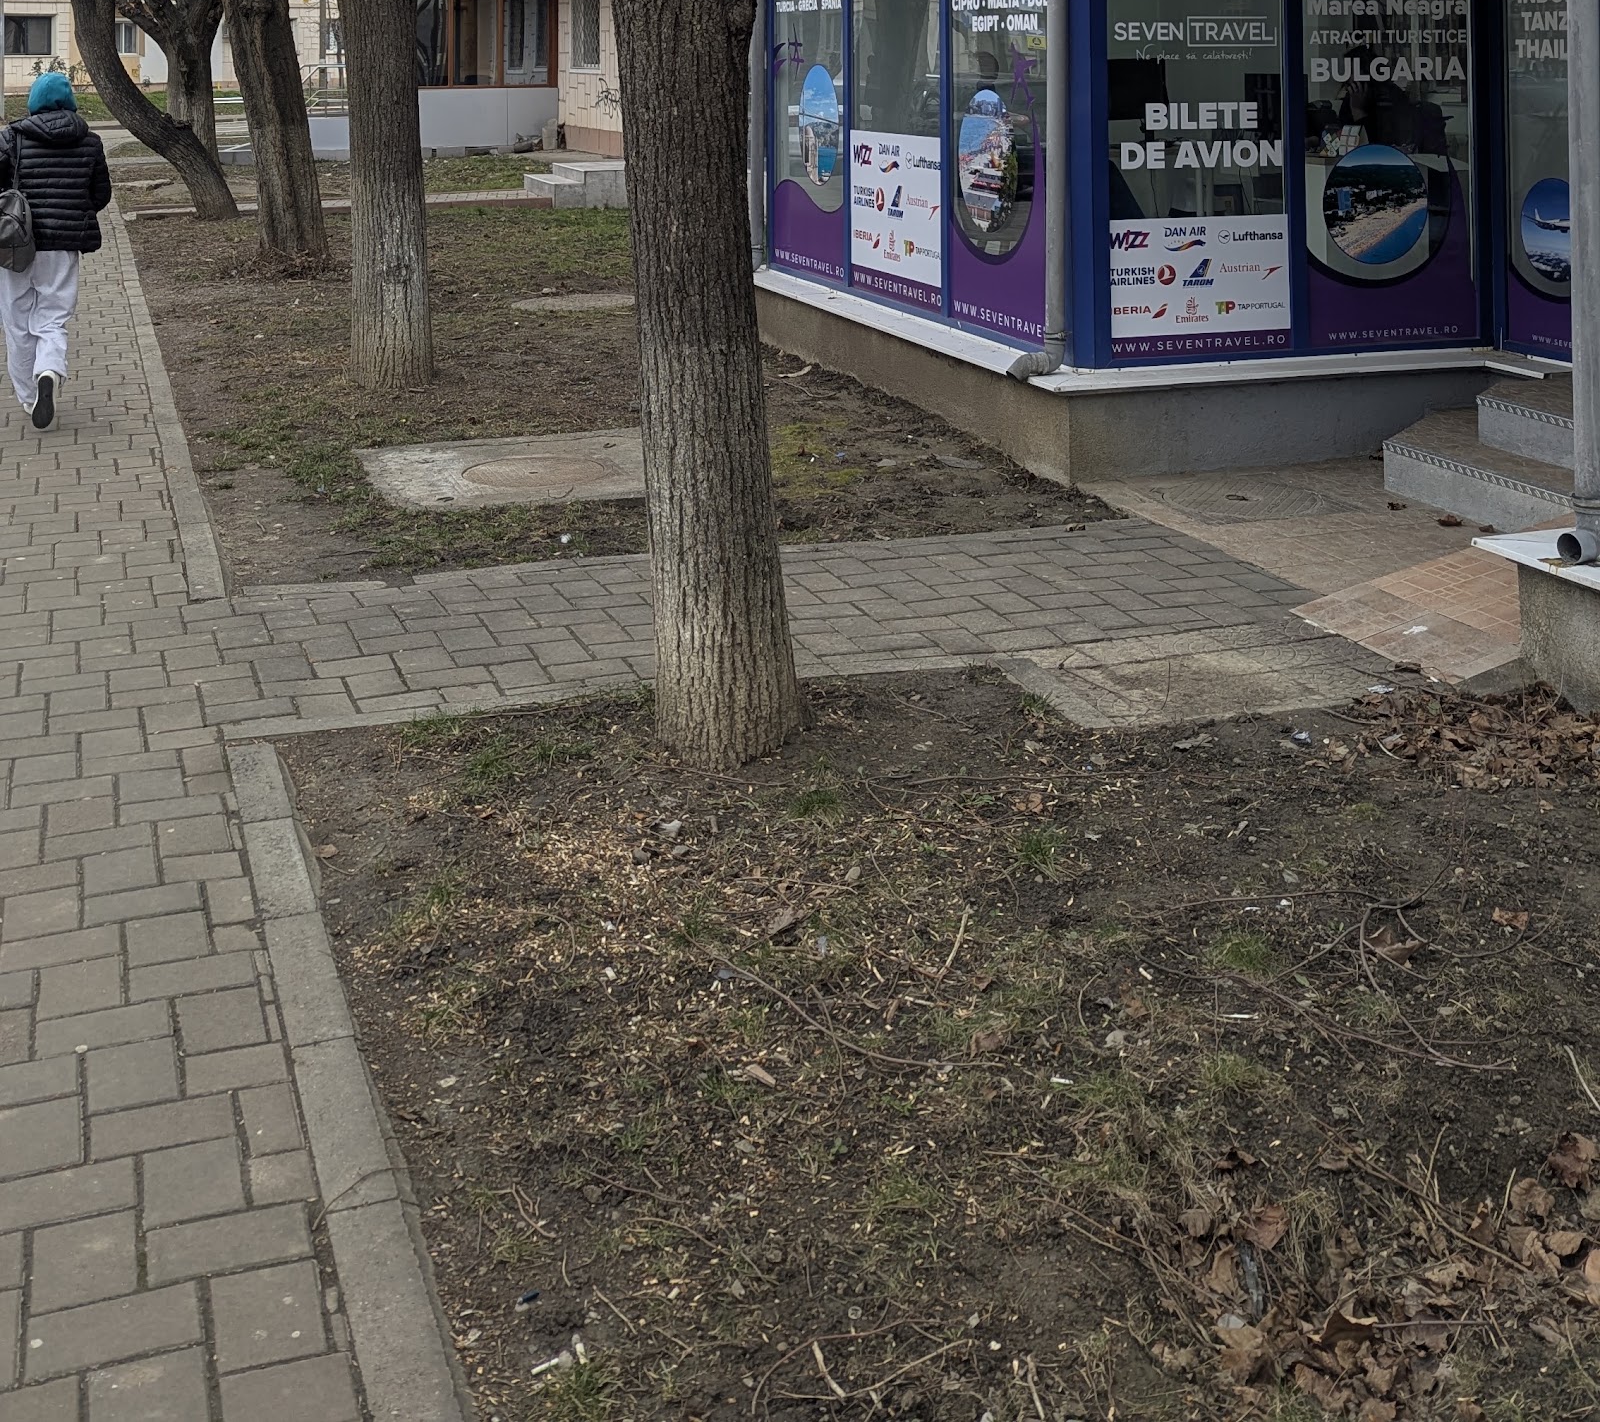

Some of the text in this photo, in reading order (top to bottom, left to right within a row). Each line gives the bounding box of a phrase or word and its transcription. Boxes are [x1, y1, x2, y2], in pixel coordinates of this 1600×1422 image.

[775, 0, 795, 13] TURCIA
[971, 13, 1038, 32] EGIPT OMAN
[1521, 10, 1567, 32] TANZ
[1113, 22, 1274, 41] SEVEN TRAVEL
[1309, 29, 1467, 49] ATRACȚII TURISTICE
[1135, 44, 1155, 61] Ne
[1156, 49, 1180, 65] place
[1515, 38, 1568, 60] THAIL
[1310, 56, 1467, 82] BULGARIA
[1145, 101, 1258, 130] BILETE
[878, 142, 900, 157] DAN AIR
[1120, 139, 1283, 170] DE AVION
[853, 185, 875, 196] TURKISH
[853, 197, 875, 208] AIRLINES
[905, 193, 929, 208] Austrian
[887, 208, 904, 219] TAROM
[853, 229, 873, 242] IBERIA
[1162, 226, 1207, 238] DAN AIR
[1232, 230, 1283, 242] Lufthansa
[774, 248, 845, 278] WWW.SEVENTRAVEL.RO
[883, 250, 901, 262] Emirates
[1110, 266, 1155, 277] TURKISH
[1219, 262, 1261, 274] Austrian
[853, 271, 943, 307] WWW.SEVENTRAVEL.RO
[1110, 276, 1156, 287] AIRLINES
[1182, 278, 1215, 287] TAROM
[953, 299, 1046, 338] WWW.SEVENTRAVE
[1175, 314, 1209, 324] Emirates
[1328, 325, 1459, 341] WWW.SEVENTRAVEL.RO
[1111, 334, 1286, 353] WWW.SEVENTRAVEL.RO
[1531, 333, 1573, 349] WWW.SEVE
